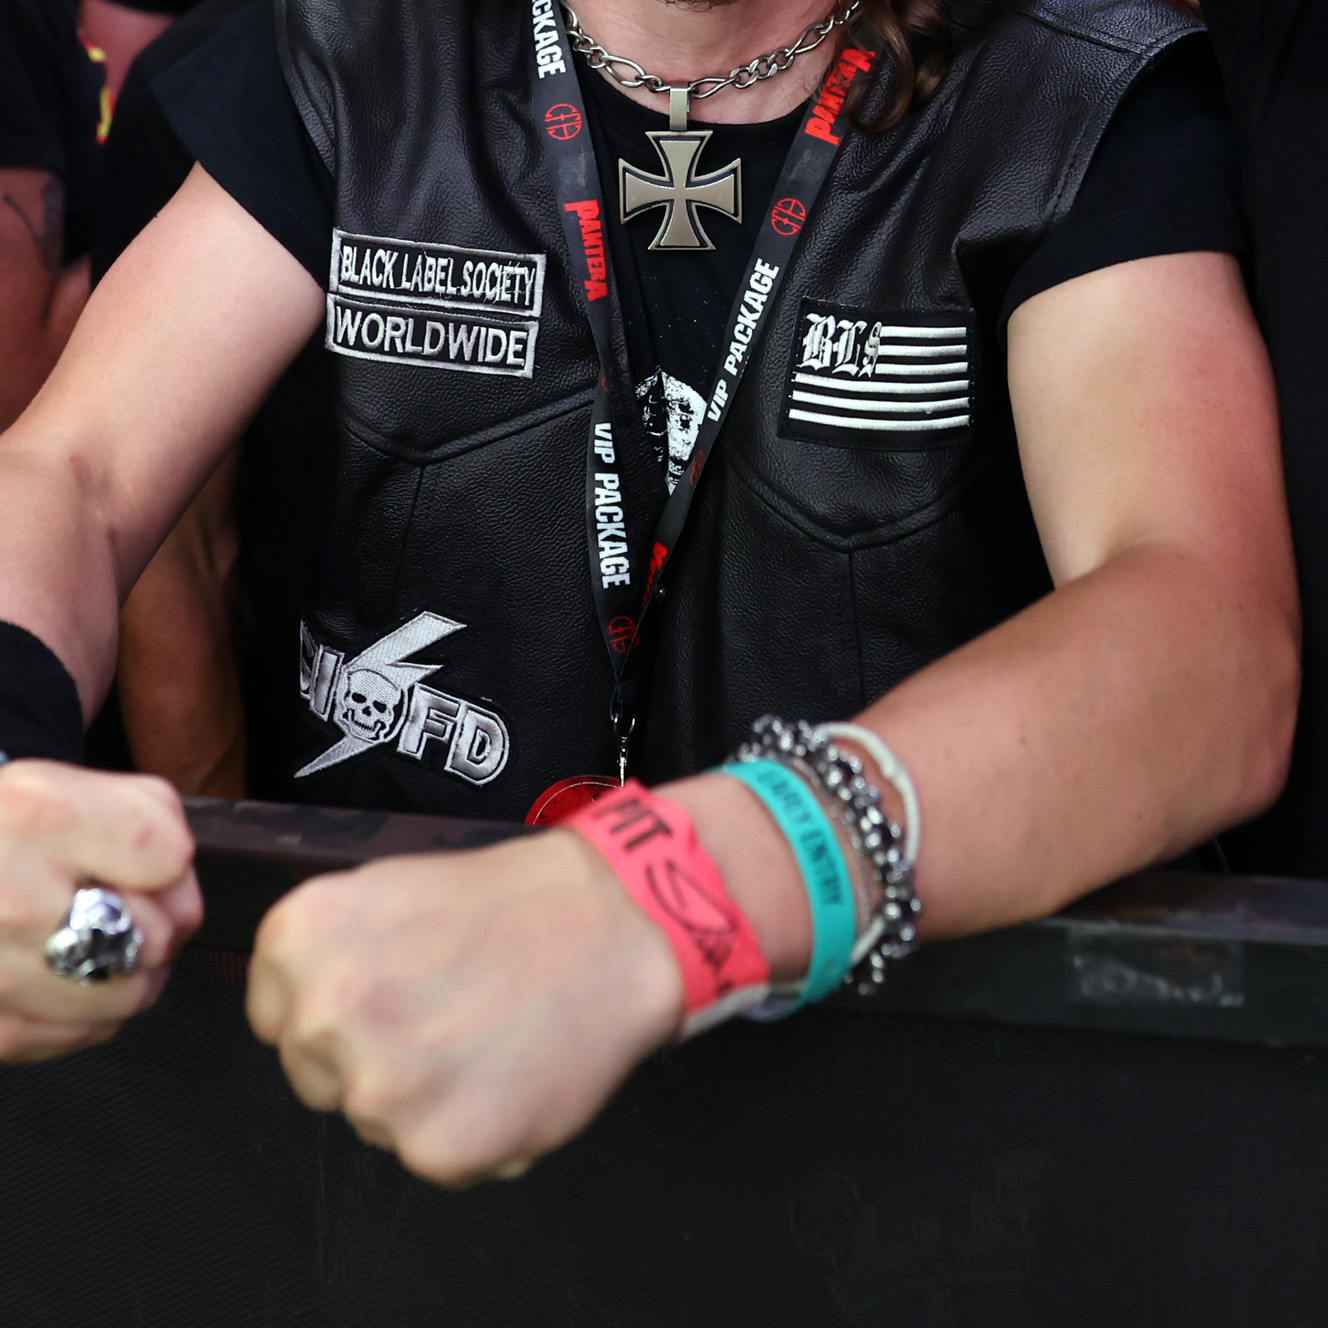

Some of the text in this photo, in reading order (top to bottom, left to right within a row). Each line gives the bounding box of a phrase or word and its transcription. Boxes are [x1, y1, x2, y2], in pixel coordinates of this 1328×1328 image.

[341, 245, 537, 306] BLACK LABEL SOCIETY
[563, 199, 609, 303] PANTERA
[335, 305, 529, 367] WORLDWIDE
[707, 258, 781, 423] VIP PACKAGE
[594, 422, 631, 590] VIP PACKAGE
